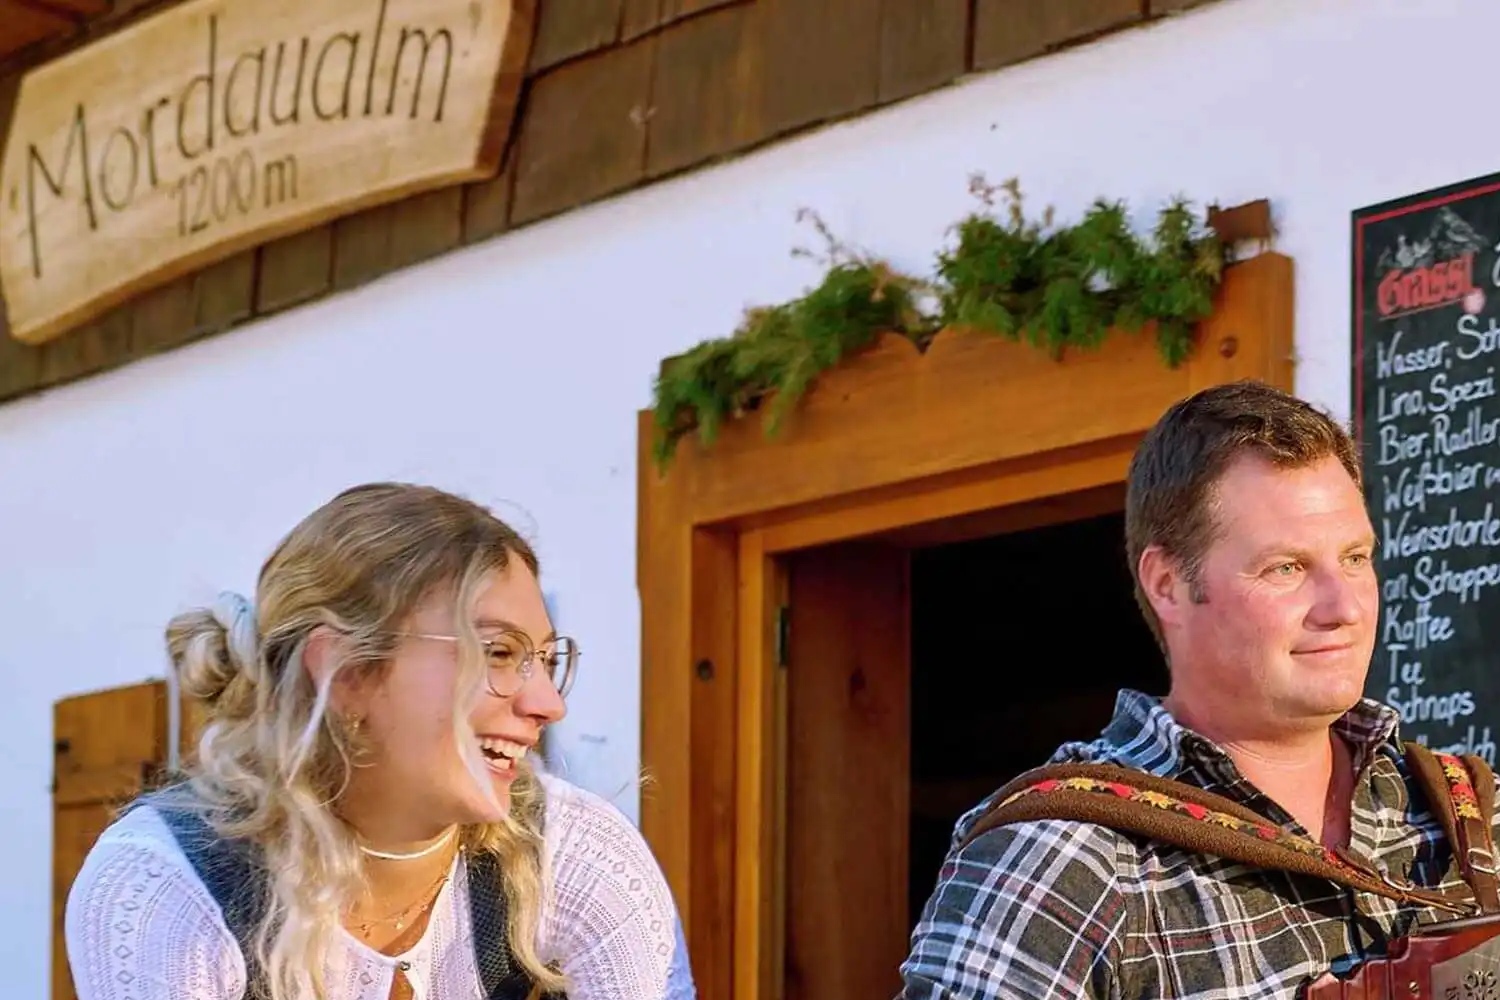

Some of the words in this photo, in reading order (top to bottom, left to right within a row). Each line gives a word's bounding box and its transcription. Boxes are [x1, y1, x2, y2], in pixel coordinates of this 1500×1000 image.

[18, 0, 454, 279] Mordaualm
[171, 149, 257, 237] 1200
[264, 153, 299, 205] m
[1428, 366, 1496, 412] Spezi
[1383, 600, 1456, 650] Kaffee
[1386, 643, 1426, 685] Tee
[1385, 685, 1477, 727] Schnaps
